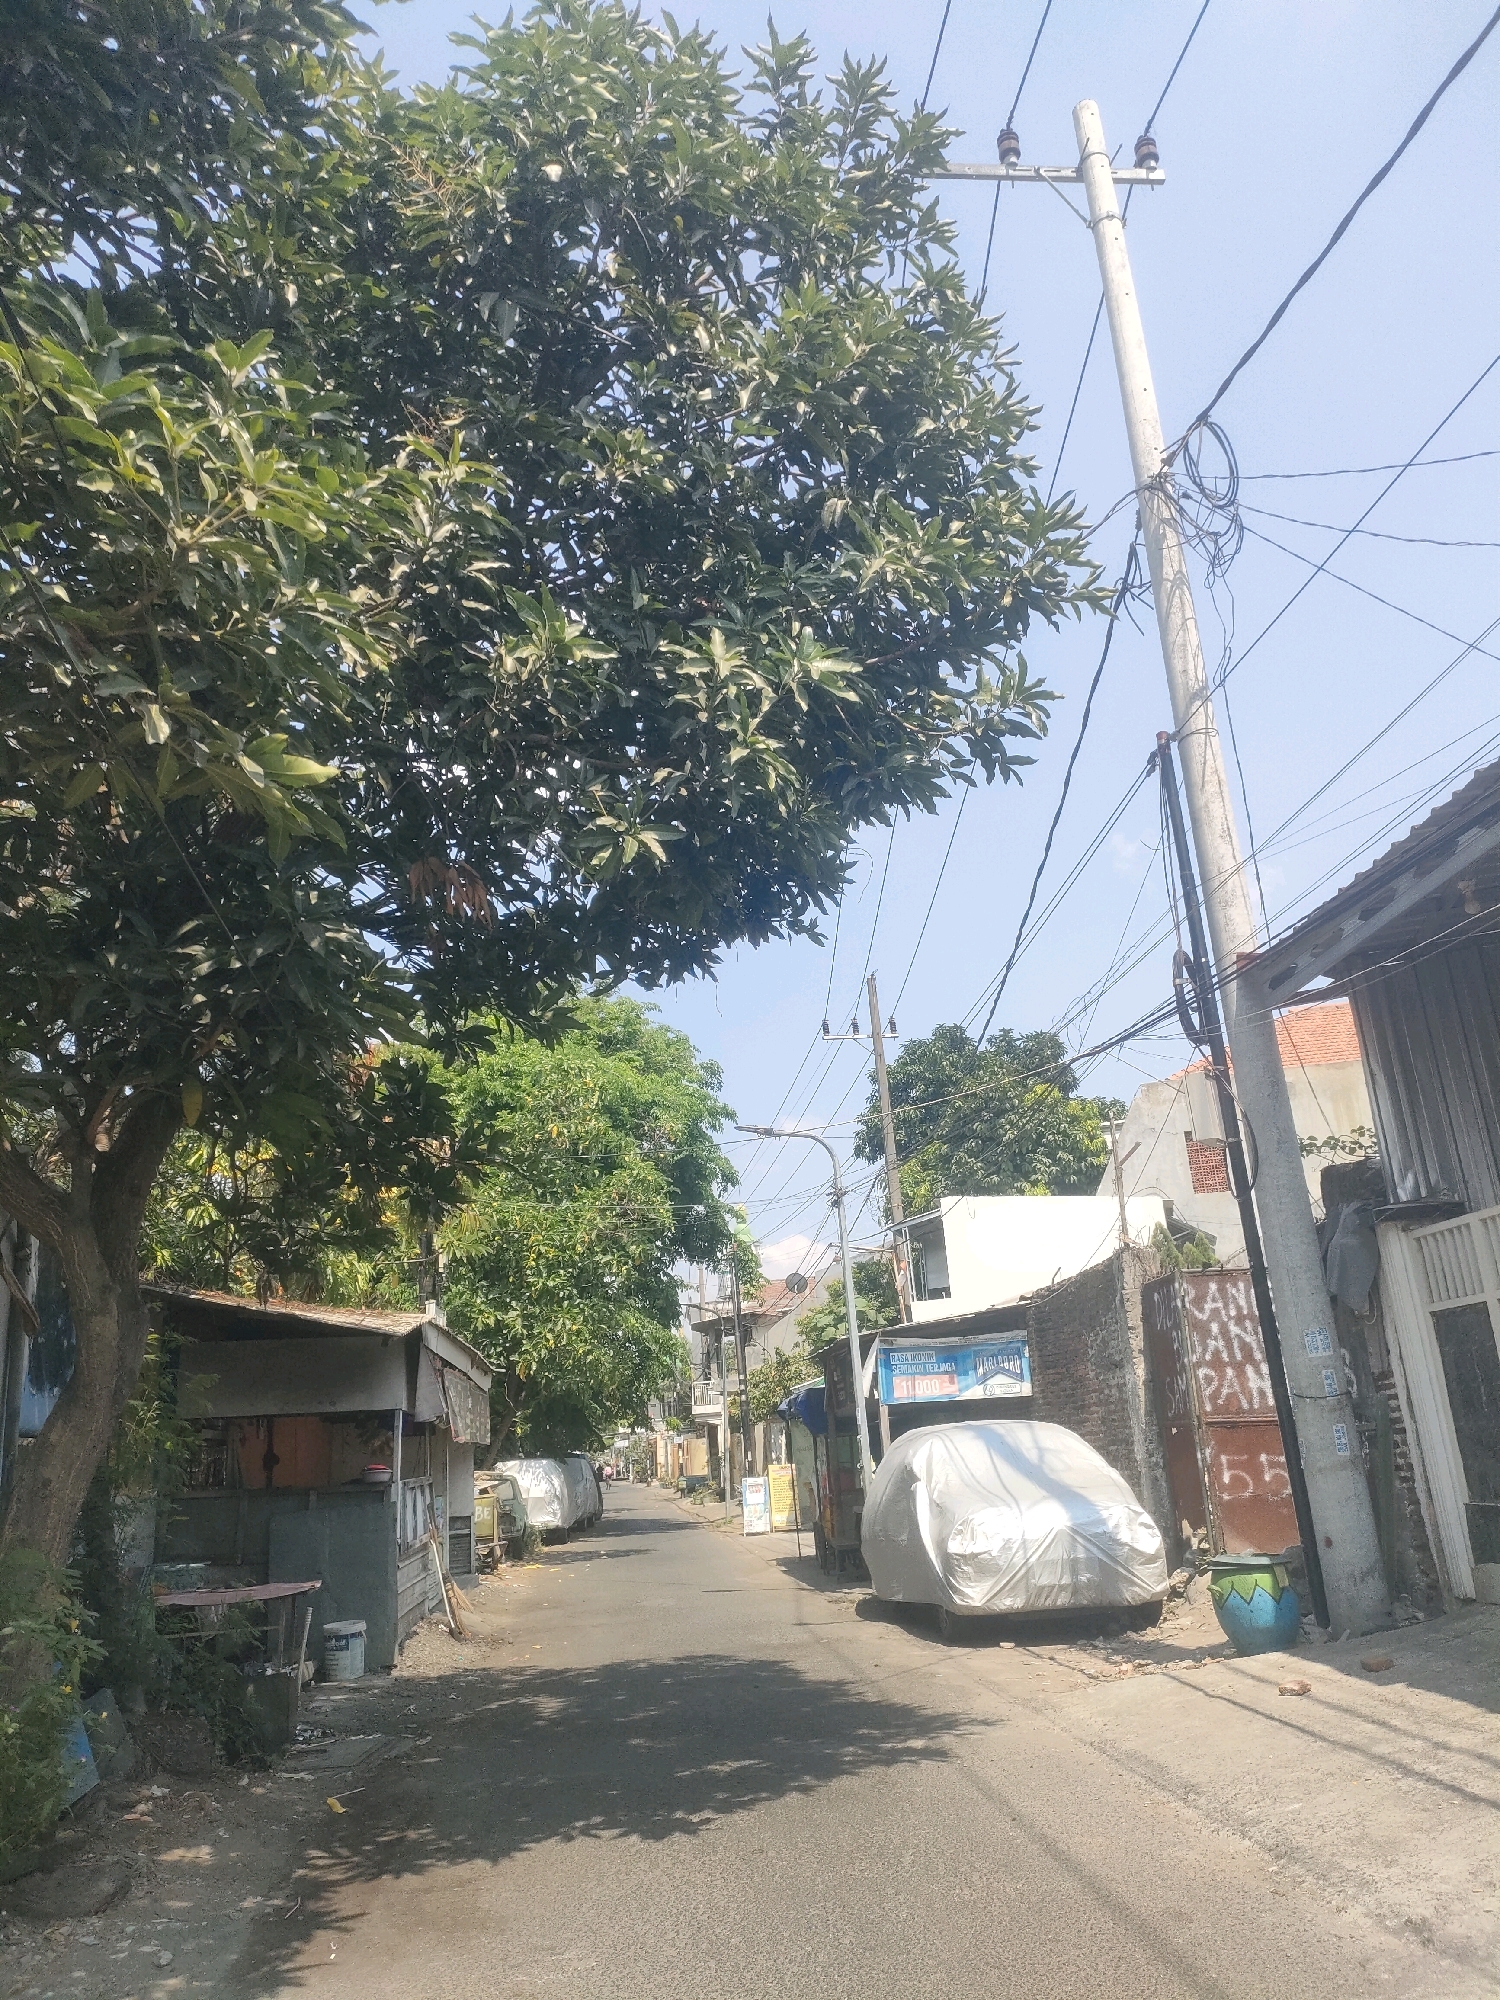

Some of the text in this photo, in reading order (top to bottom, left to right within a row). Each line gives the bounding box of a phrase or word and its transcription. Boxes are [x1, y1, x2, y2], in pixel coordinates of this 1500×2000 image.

[891, 1354, 909, 1363] RASA
[892, 1362, 956, 1374] SEMAKIN TERJAGA
[976, 1355, 1021, 1377] MARLBORO
